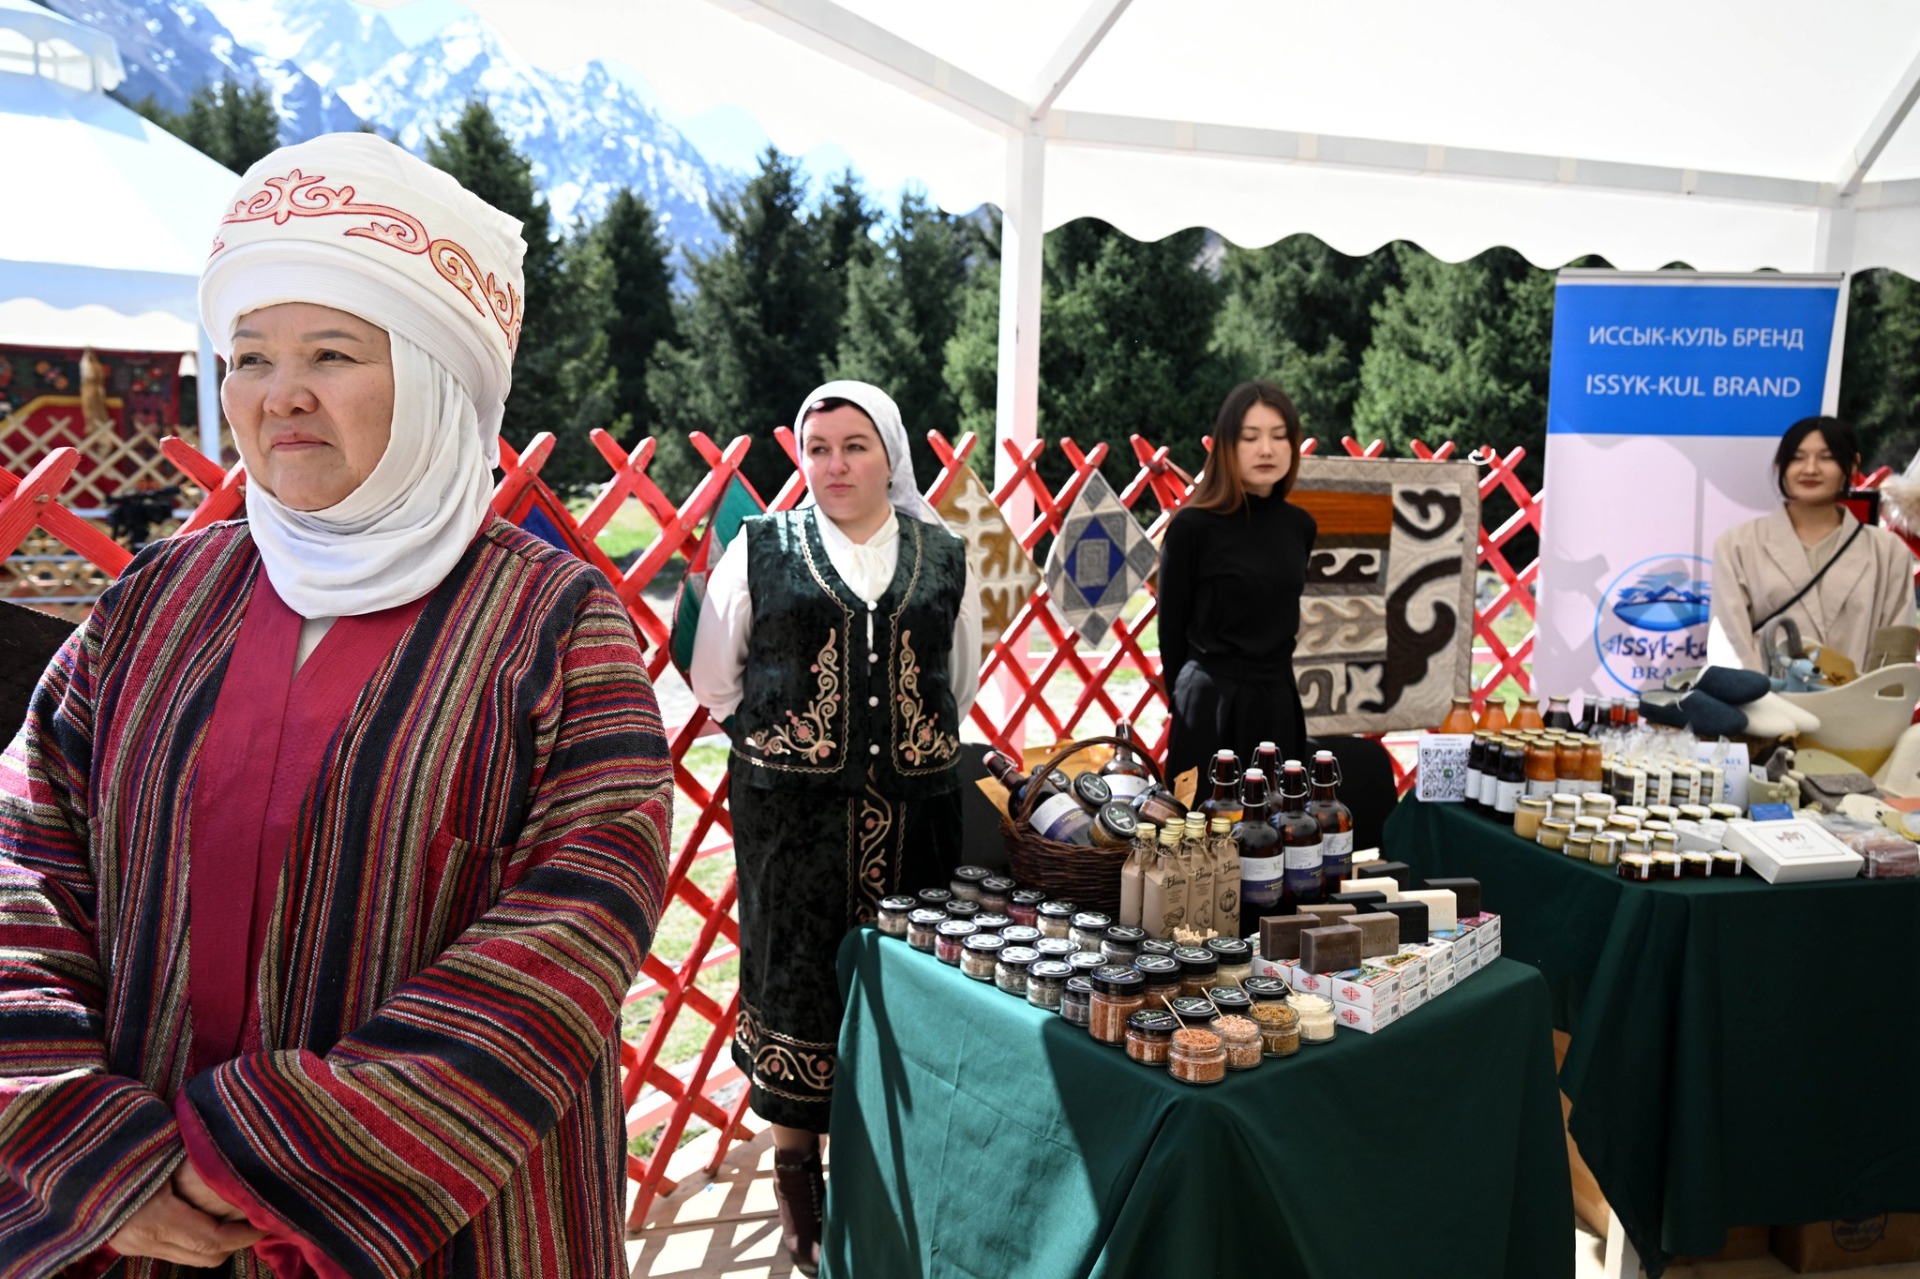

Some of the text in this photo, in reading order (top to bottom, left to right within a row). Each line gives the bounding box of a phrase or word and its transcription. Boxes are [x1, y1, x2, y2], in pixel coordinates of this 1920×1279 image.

[1589, 326, 1804, 351] ИССЫК-КУЛЬ БРЕНД
[1585, 374, 1801, 398] ISSYK-KUL BRAND
[1615, 633, 1707, 660] Issyk-ku
[1632, 665, 1682, 680] BRA
